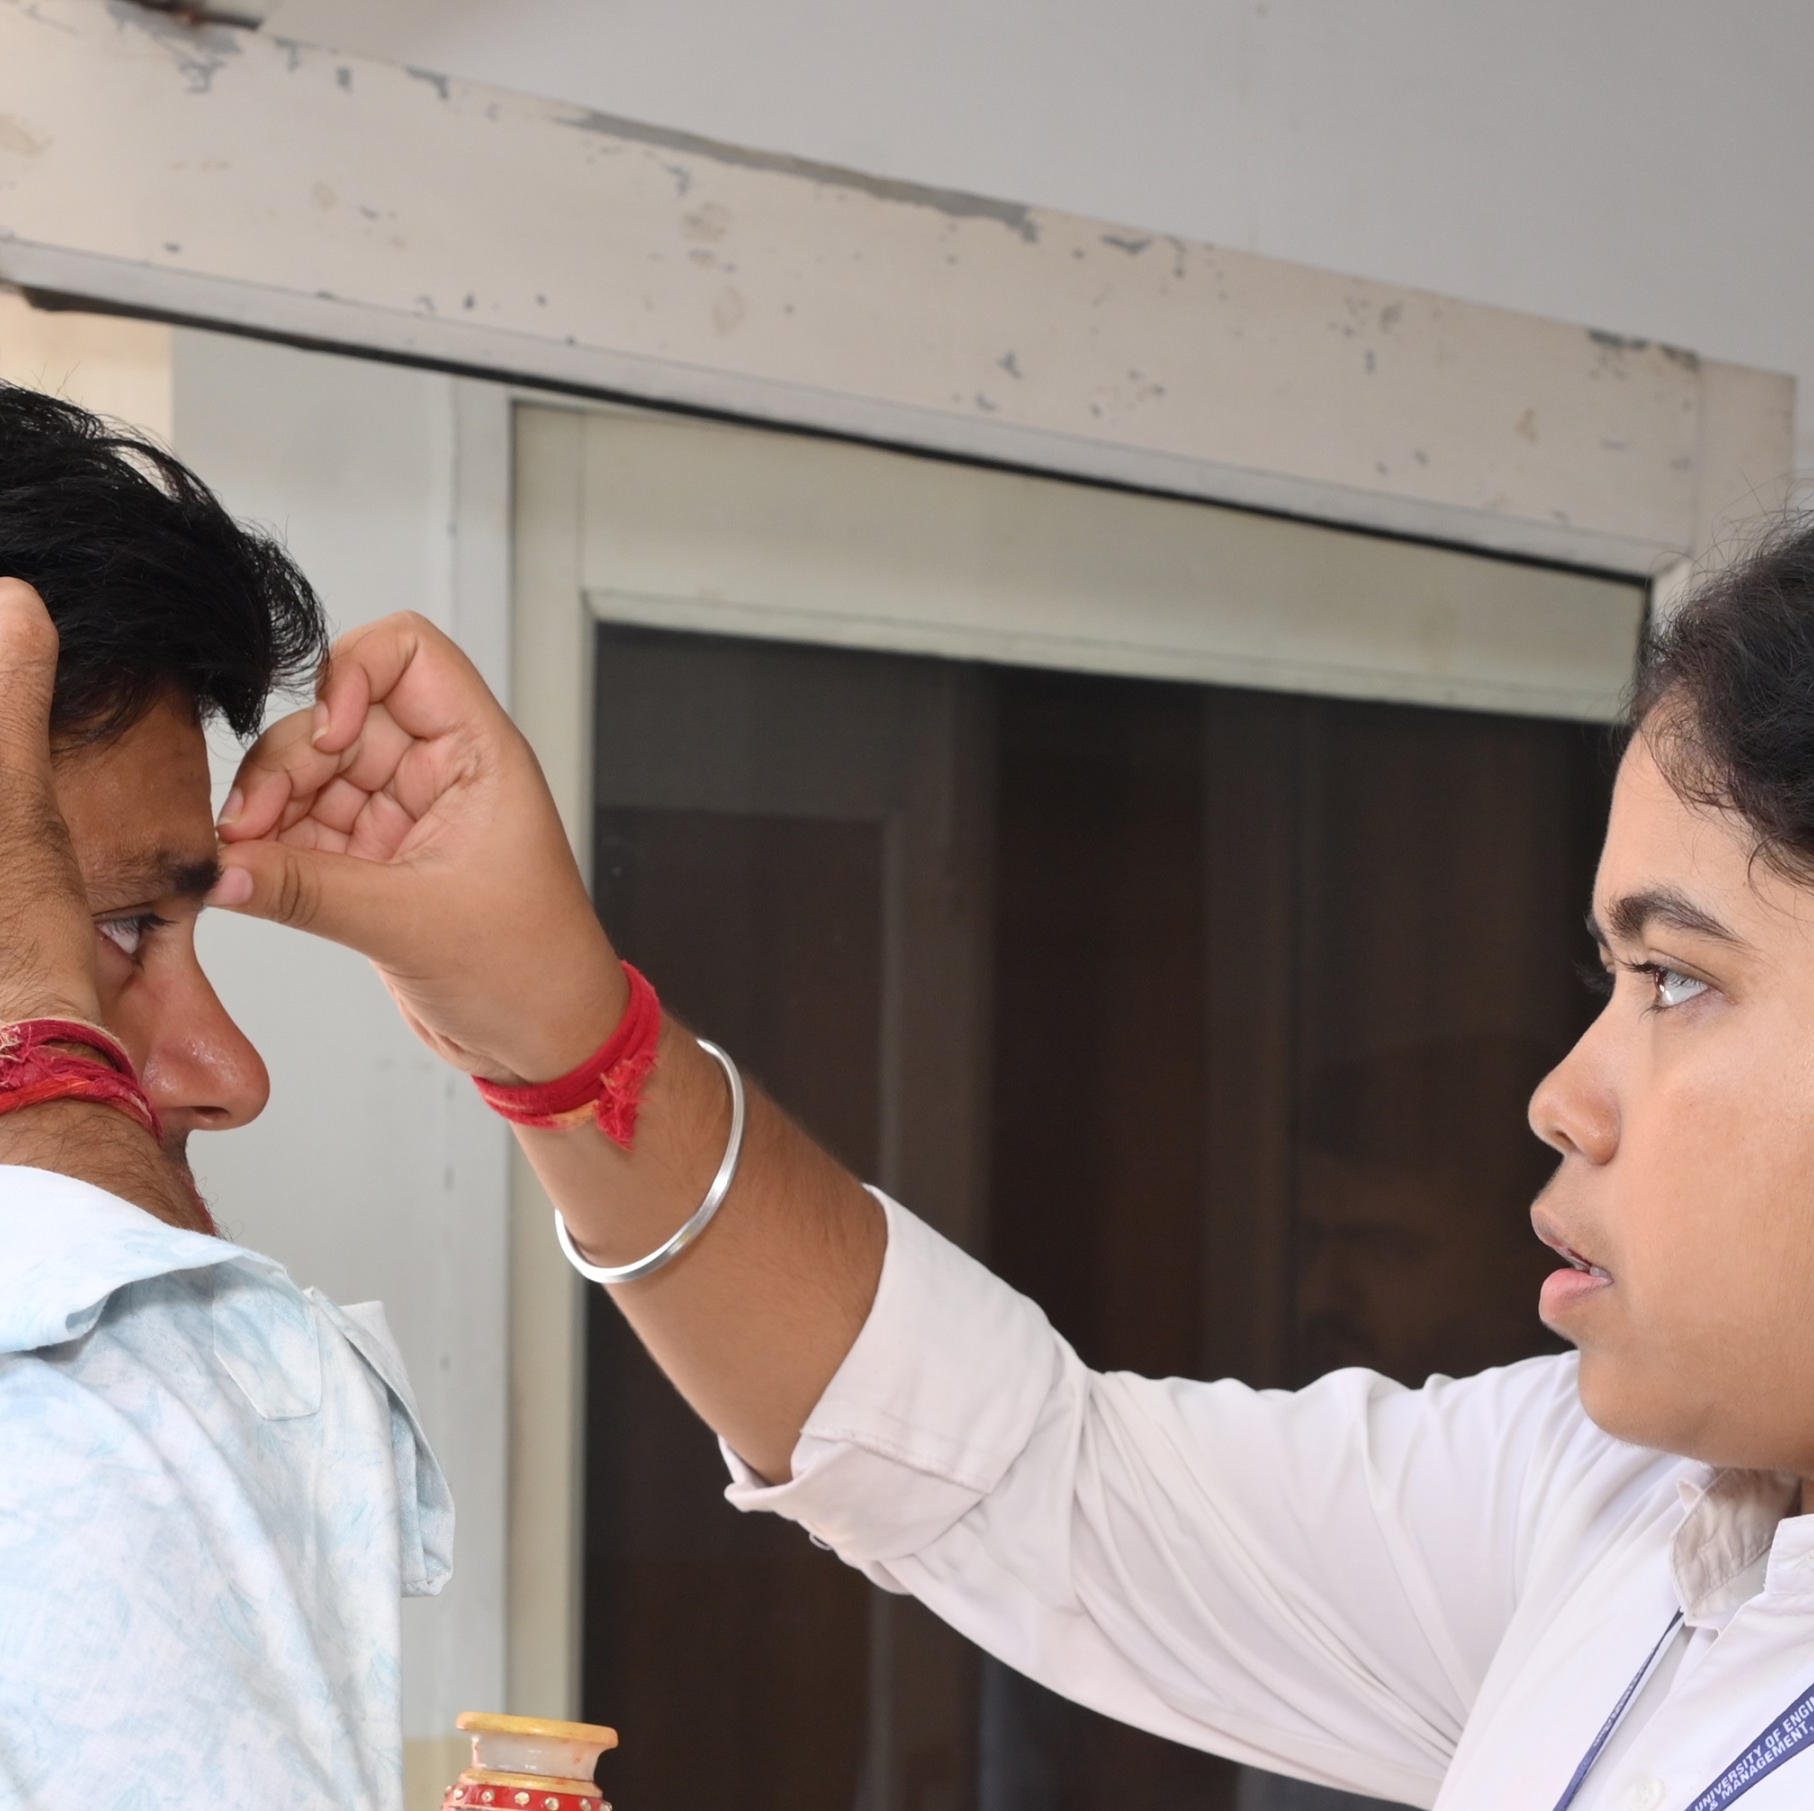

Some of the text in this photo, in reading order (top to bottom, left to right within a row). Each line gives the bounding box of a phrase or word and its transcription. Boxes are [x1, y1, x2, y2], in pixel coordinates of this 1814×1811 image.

[1709, 1799, 1719, 1811] &
[1721, 1721, 1814, 1801] MANAGEMENT,
[1764, 1728, 1782, 1749] OF
